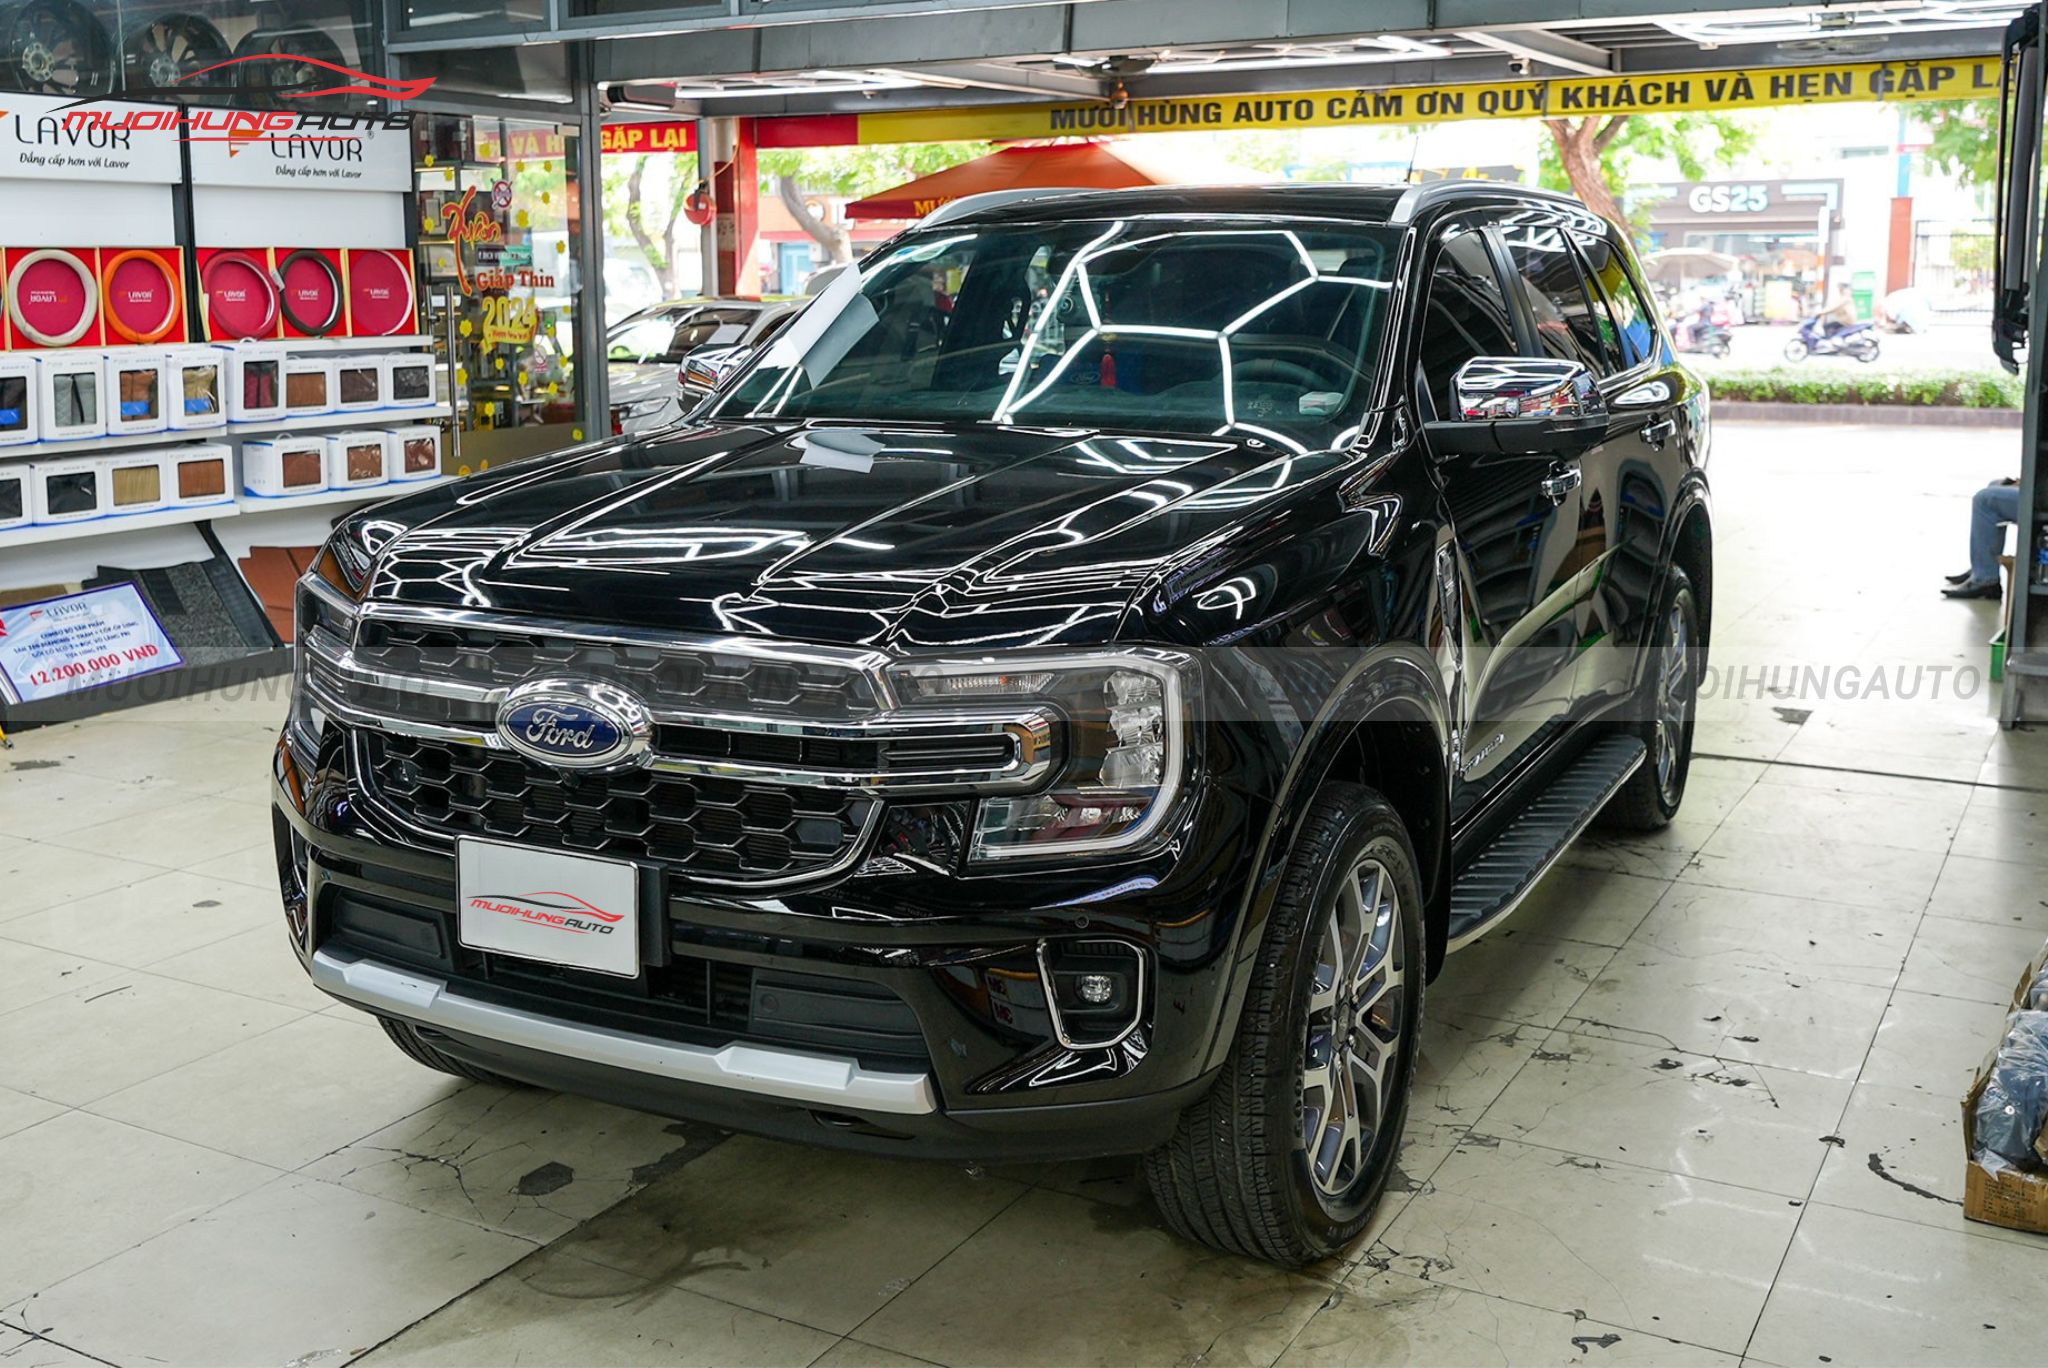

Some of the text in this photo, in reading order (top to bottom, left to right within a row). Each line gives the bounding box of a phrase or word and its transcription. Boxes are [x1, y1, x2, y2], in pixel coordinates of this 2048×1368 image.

[1137, 99, 1222, 125] HÙNG
[1233, 99, 1314, 123] AUTO
[1416, 91, 1464, 115] ƠN
[1478, 83, 1544, 116] QUÝ
[1561, 79, 1690, 109] KHÁCH
[1704, 73, 1755, 101] VÀ
[1770, 71, 1853, 102] HẸN
[1869, 60, 1955, 98] GẶP
[15, 114, 130, 150] LAVOR
[270, 132, 363, 162] LAVOR
[600, 126, 643, 153] GẶP
[651, 128, 688, 152] LẠI
[49, 153, 66, 167] cấp
[67, 155, 86, 167] hơn
[88, 155, 102, 167] với
[104, 157, 130, 169] Lavor
[341, 169, 362, 179] Lavor
[1688, 184, 1769, 213] GS25
[476, 267, 515, 290] Giáp
[482, 296, 538, 331] 2024
[30, 653, 121, 687] 12.200.000
[124, 644, 160, 662] VND
[526, 706, 596, 750] Ford
[469, 898, 616, 935] MUOIHUNGAUTO
